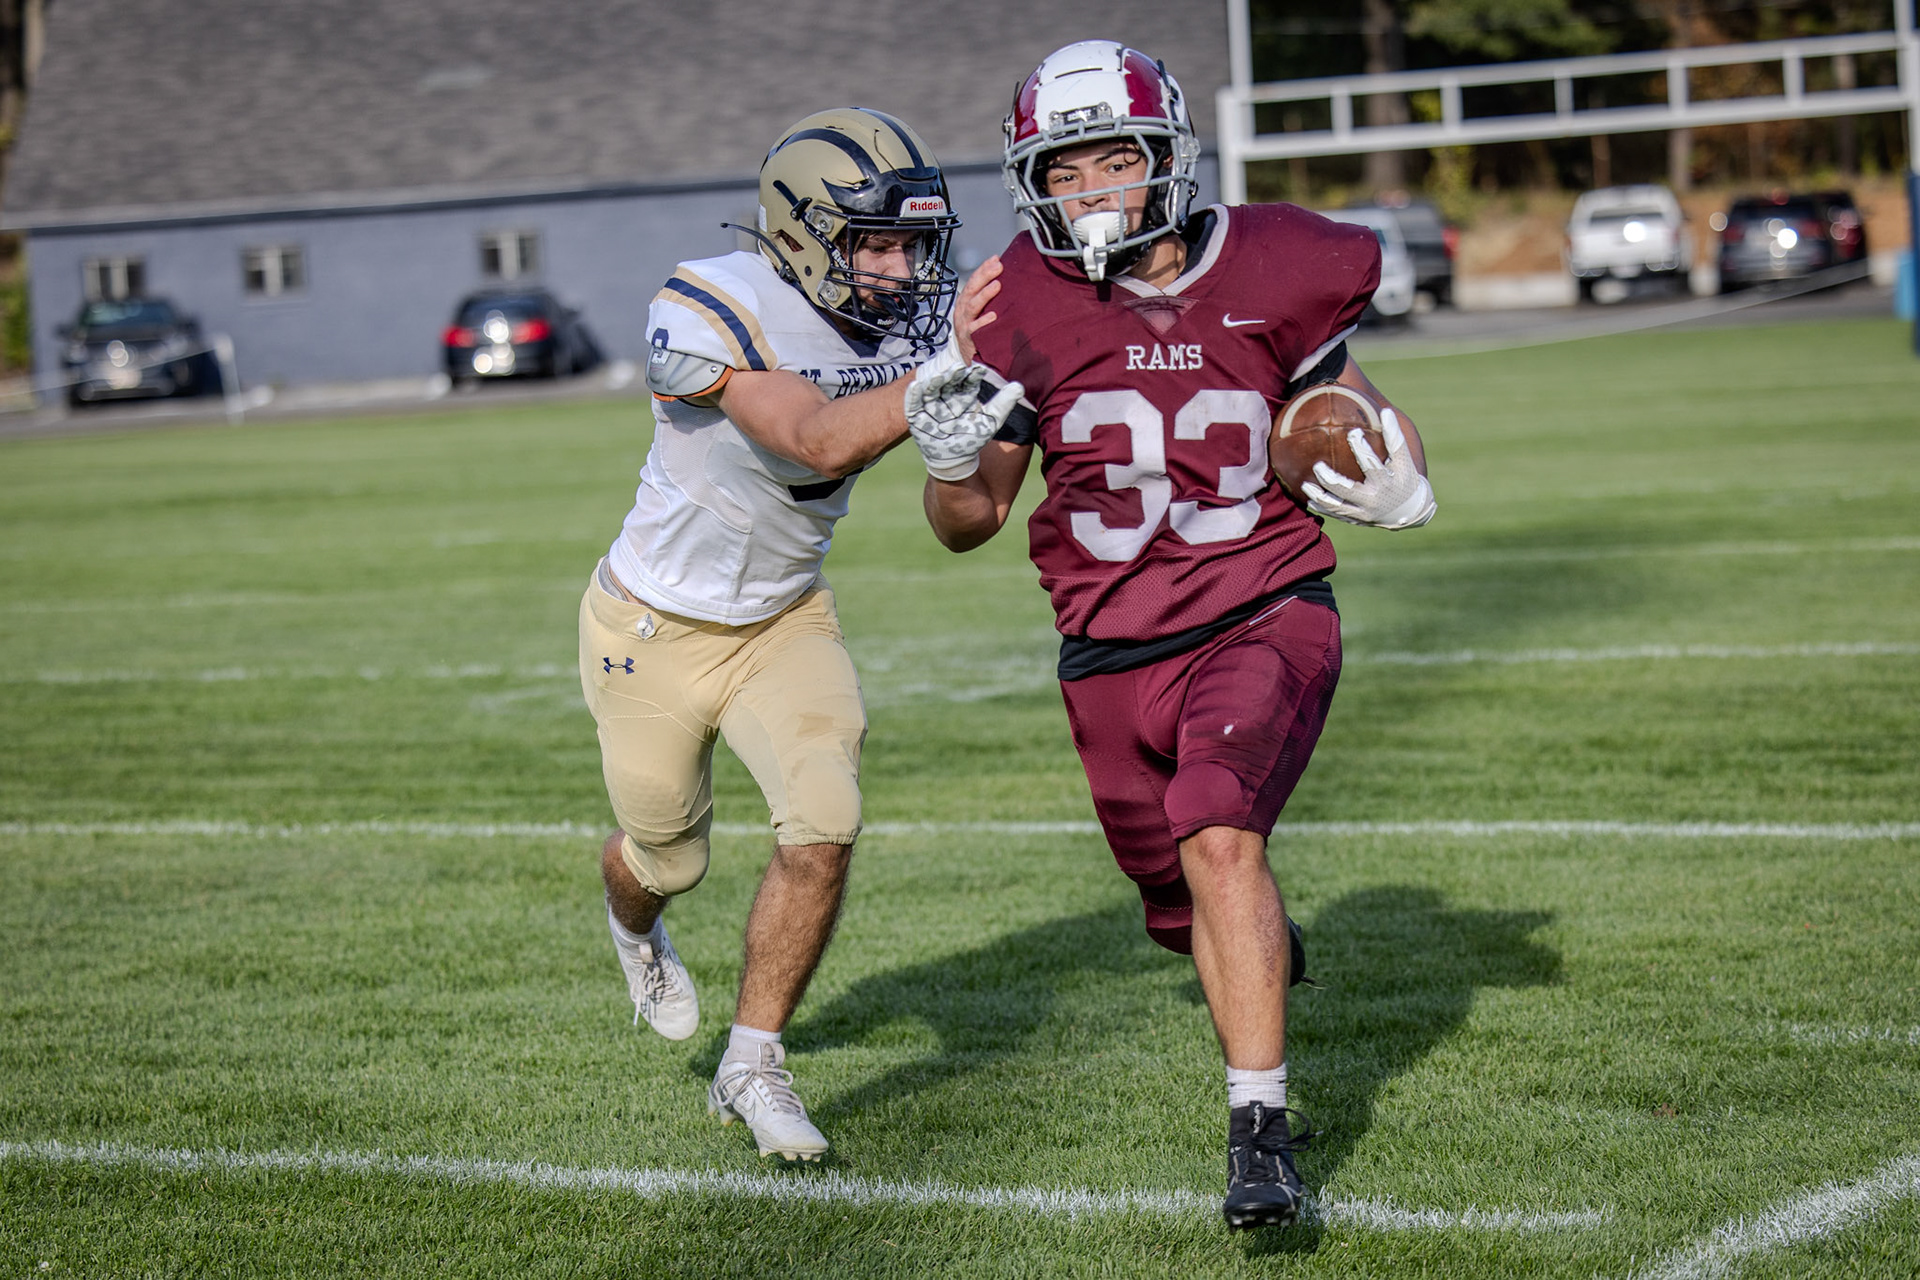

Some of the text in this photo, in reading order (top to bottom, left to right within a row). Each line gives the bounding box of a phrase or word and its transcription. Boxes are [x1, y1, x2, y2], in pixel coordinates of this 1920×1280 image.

[910, 201, 943, 211] Riddell
[1125, 343, 1204, 371] RAMS
[1061, 389, 1272, 562] 33
